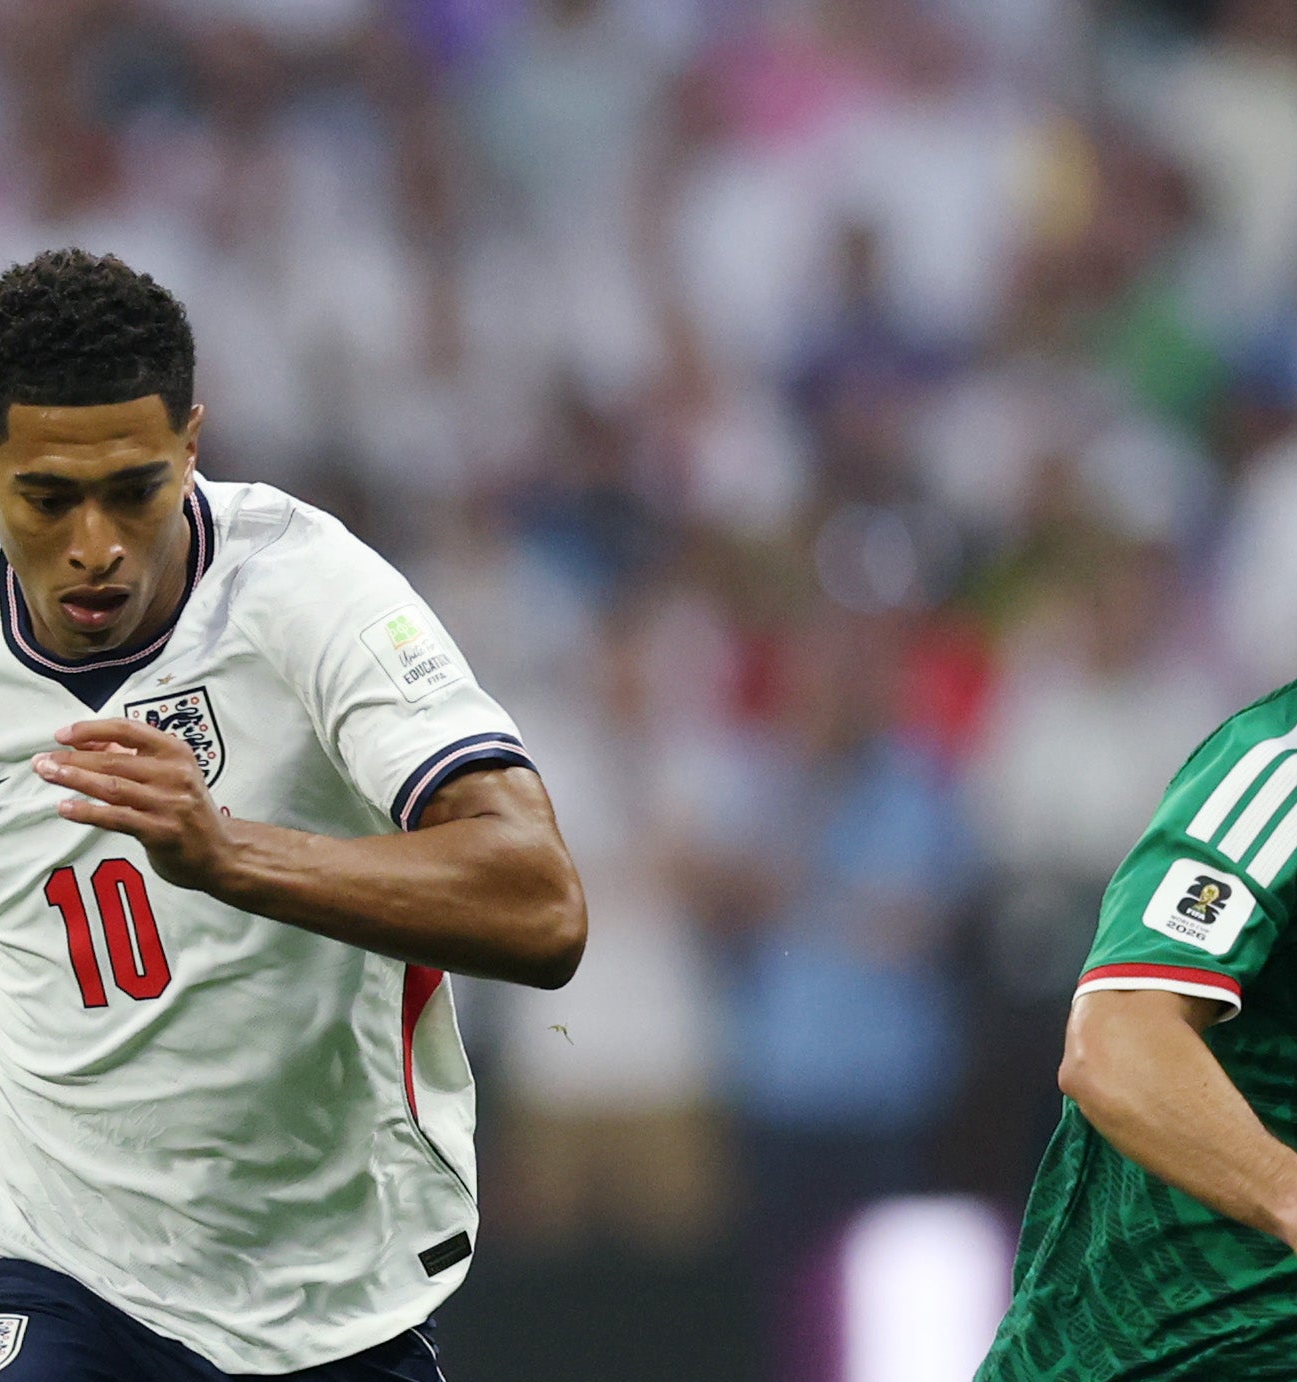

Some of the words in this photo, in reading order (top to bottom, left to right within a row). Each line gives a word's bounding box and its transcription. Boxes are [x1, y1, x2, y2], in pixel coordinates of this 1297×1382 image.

[426, 672, 447, 685] FIFA
[1185, 907, 1206, 921] FIFA
[44, 857, 172, 1009] 10
[1166, 920, 1207, 941] 2026
